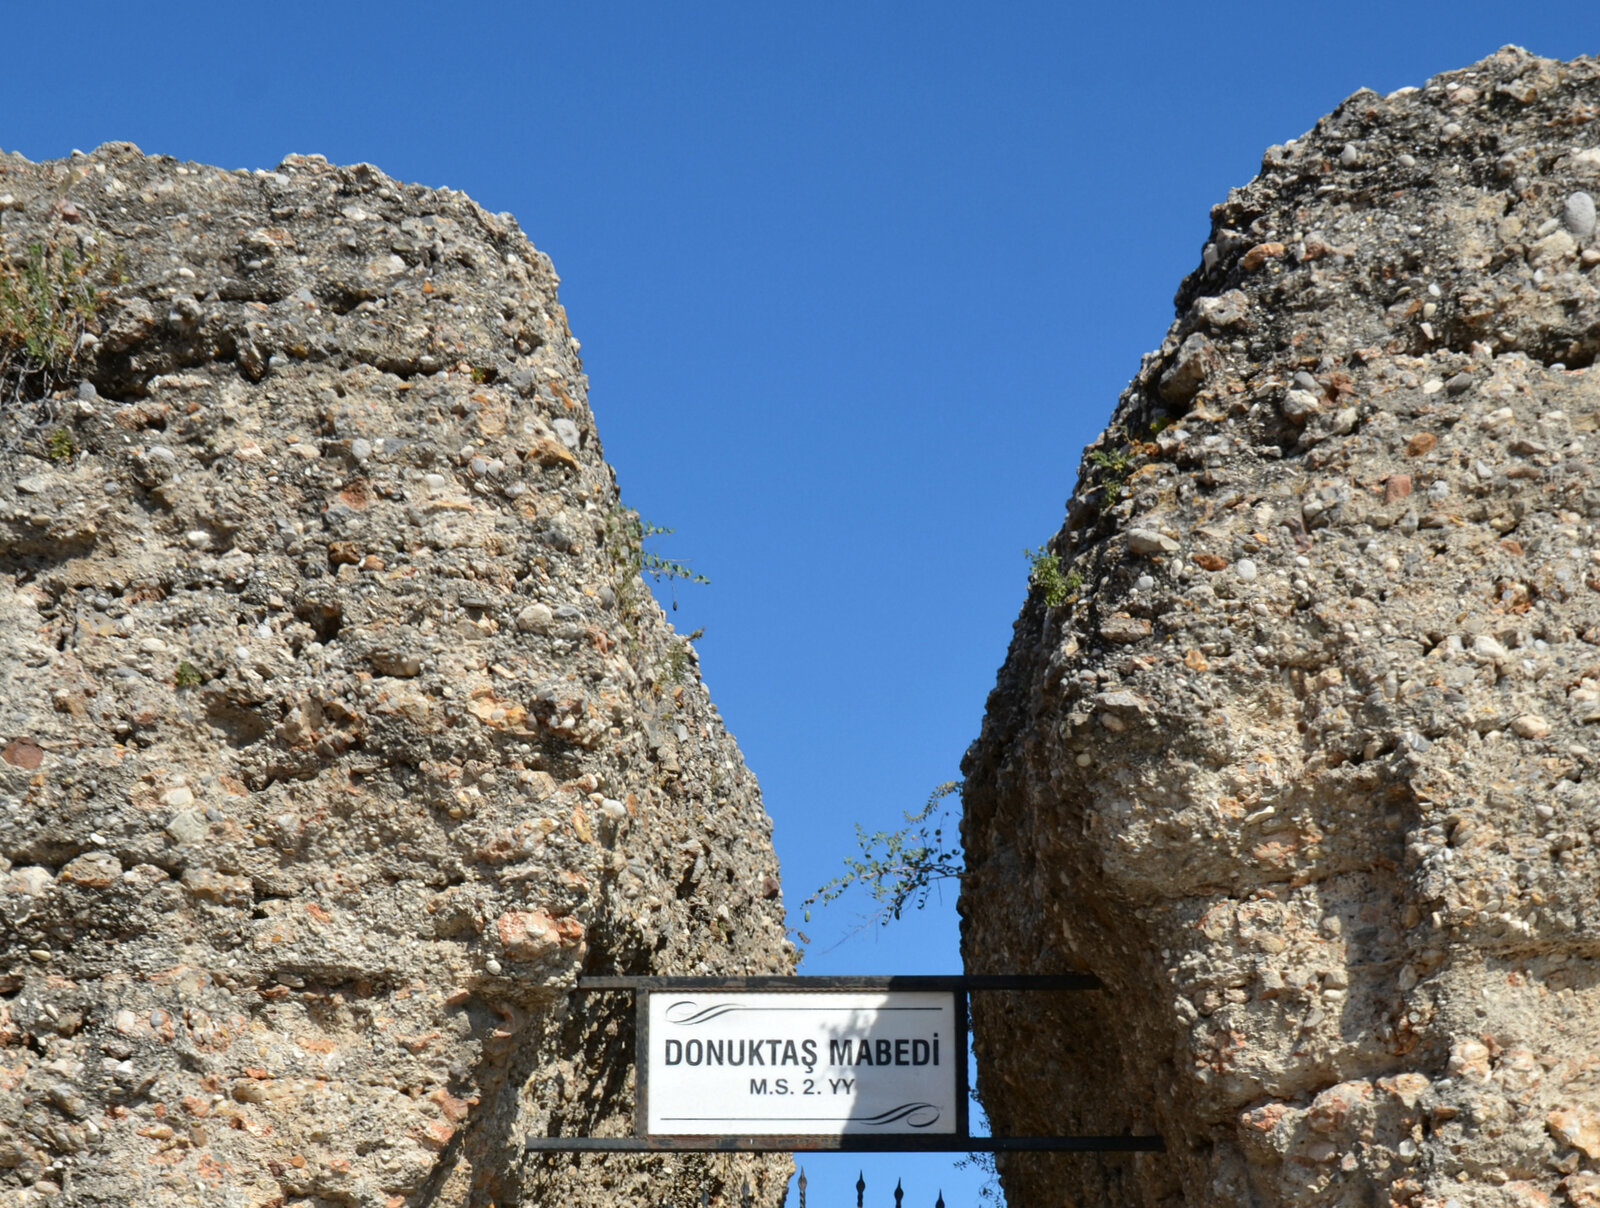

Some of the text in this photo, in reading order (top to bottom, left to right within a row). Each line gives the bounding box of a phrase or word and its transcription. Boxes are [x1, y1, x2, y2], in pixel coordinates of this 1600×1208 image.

[664, 1032, 940, 1073] DONUKTAŞ MABEDİ
[749, 1078, 856, 1095] M.S. 2. YY
